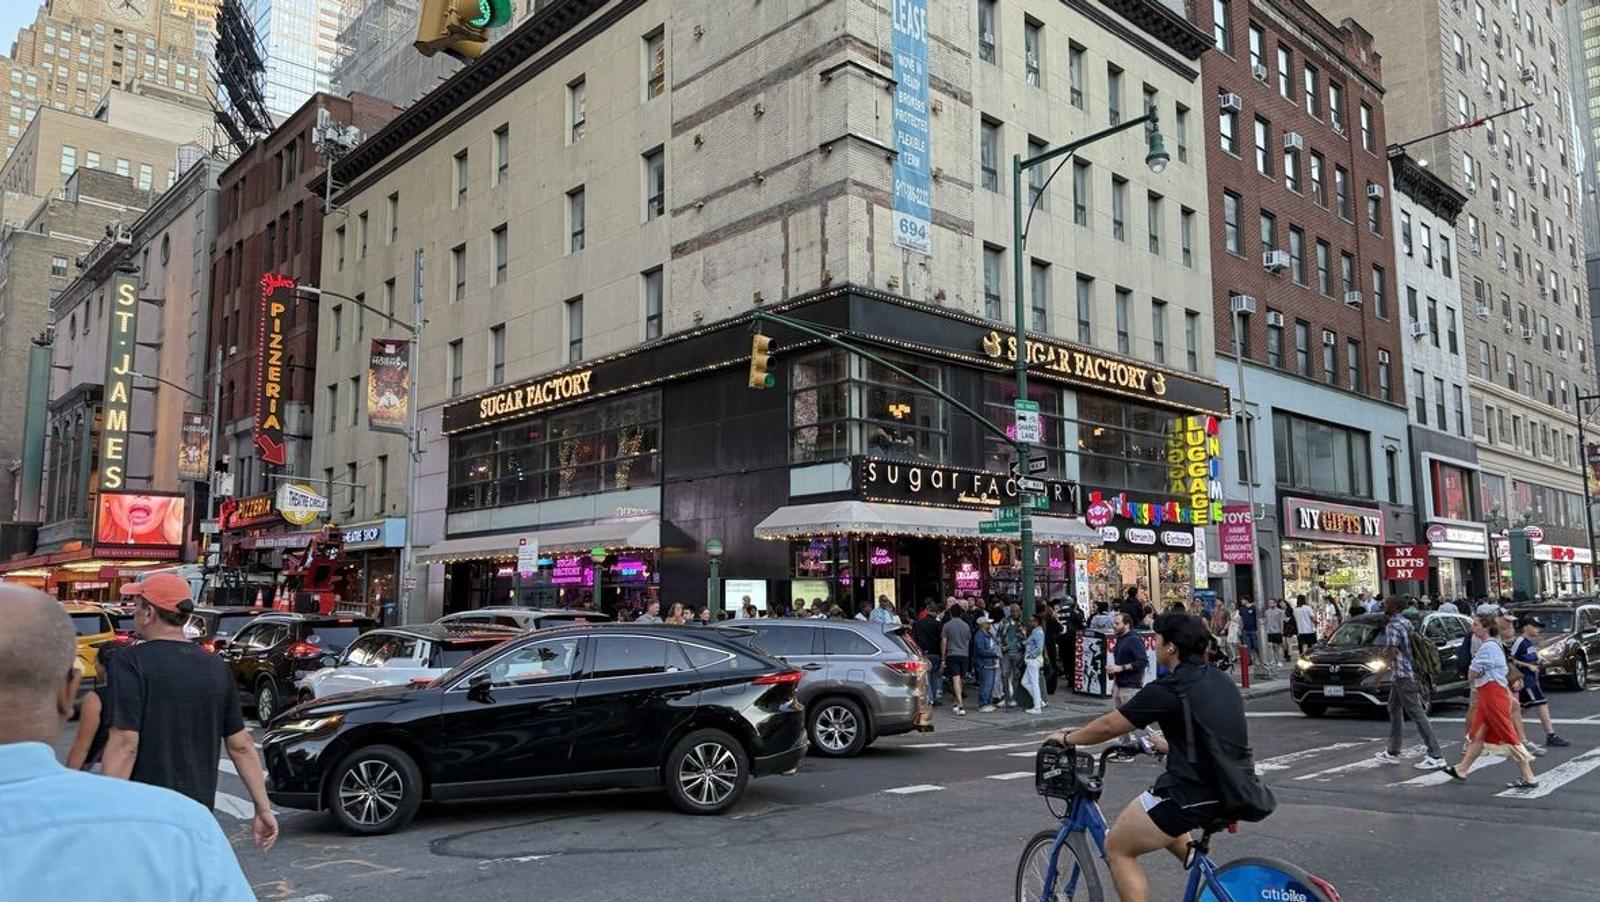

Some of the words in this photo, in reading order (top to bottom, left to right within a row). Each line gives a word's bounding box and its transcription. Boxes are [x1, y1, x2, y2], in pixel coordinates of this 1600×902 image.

[893, 0, 927, 43] LEASE
[898, 54, 916, 72] MOVE
[898, 91, 926, 113] BROKERS
[895, 108, 928, 132] PROTECTED
[898, 131, 926, 152] FLEXIBLE
[903, 152, 920, 167] TERM
[899, 218, 926, 240] 694
[263, 302, 285, 430] PIZZERIA
[1073, 352, 1148, 391] FACTORY
[479, 390, 524, 419] SUGAR
[526, 370, 593, 408] FACTORY
[105, 354, 130, 488] JAMES
[1186, 416, 1208, 525] LUGGAGE
[1088, 505, 1108, 517] TOY
[1222, 511, 1252, 524] TOYS
[1299, 507, 1319, 530] NY
[1322, 511, 1361, 534] GIFTS
[1363, 516, 1381, 536] NY
[363, 527, 379, 541] SHOP
[1225, 535, 1250, 543] LUGGAGE
[1396, 547, 1413, 556] NY
[1386, 558, 1424, 568] GIFTS
[1397, 569, 1414, 578] NY
